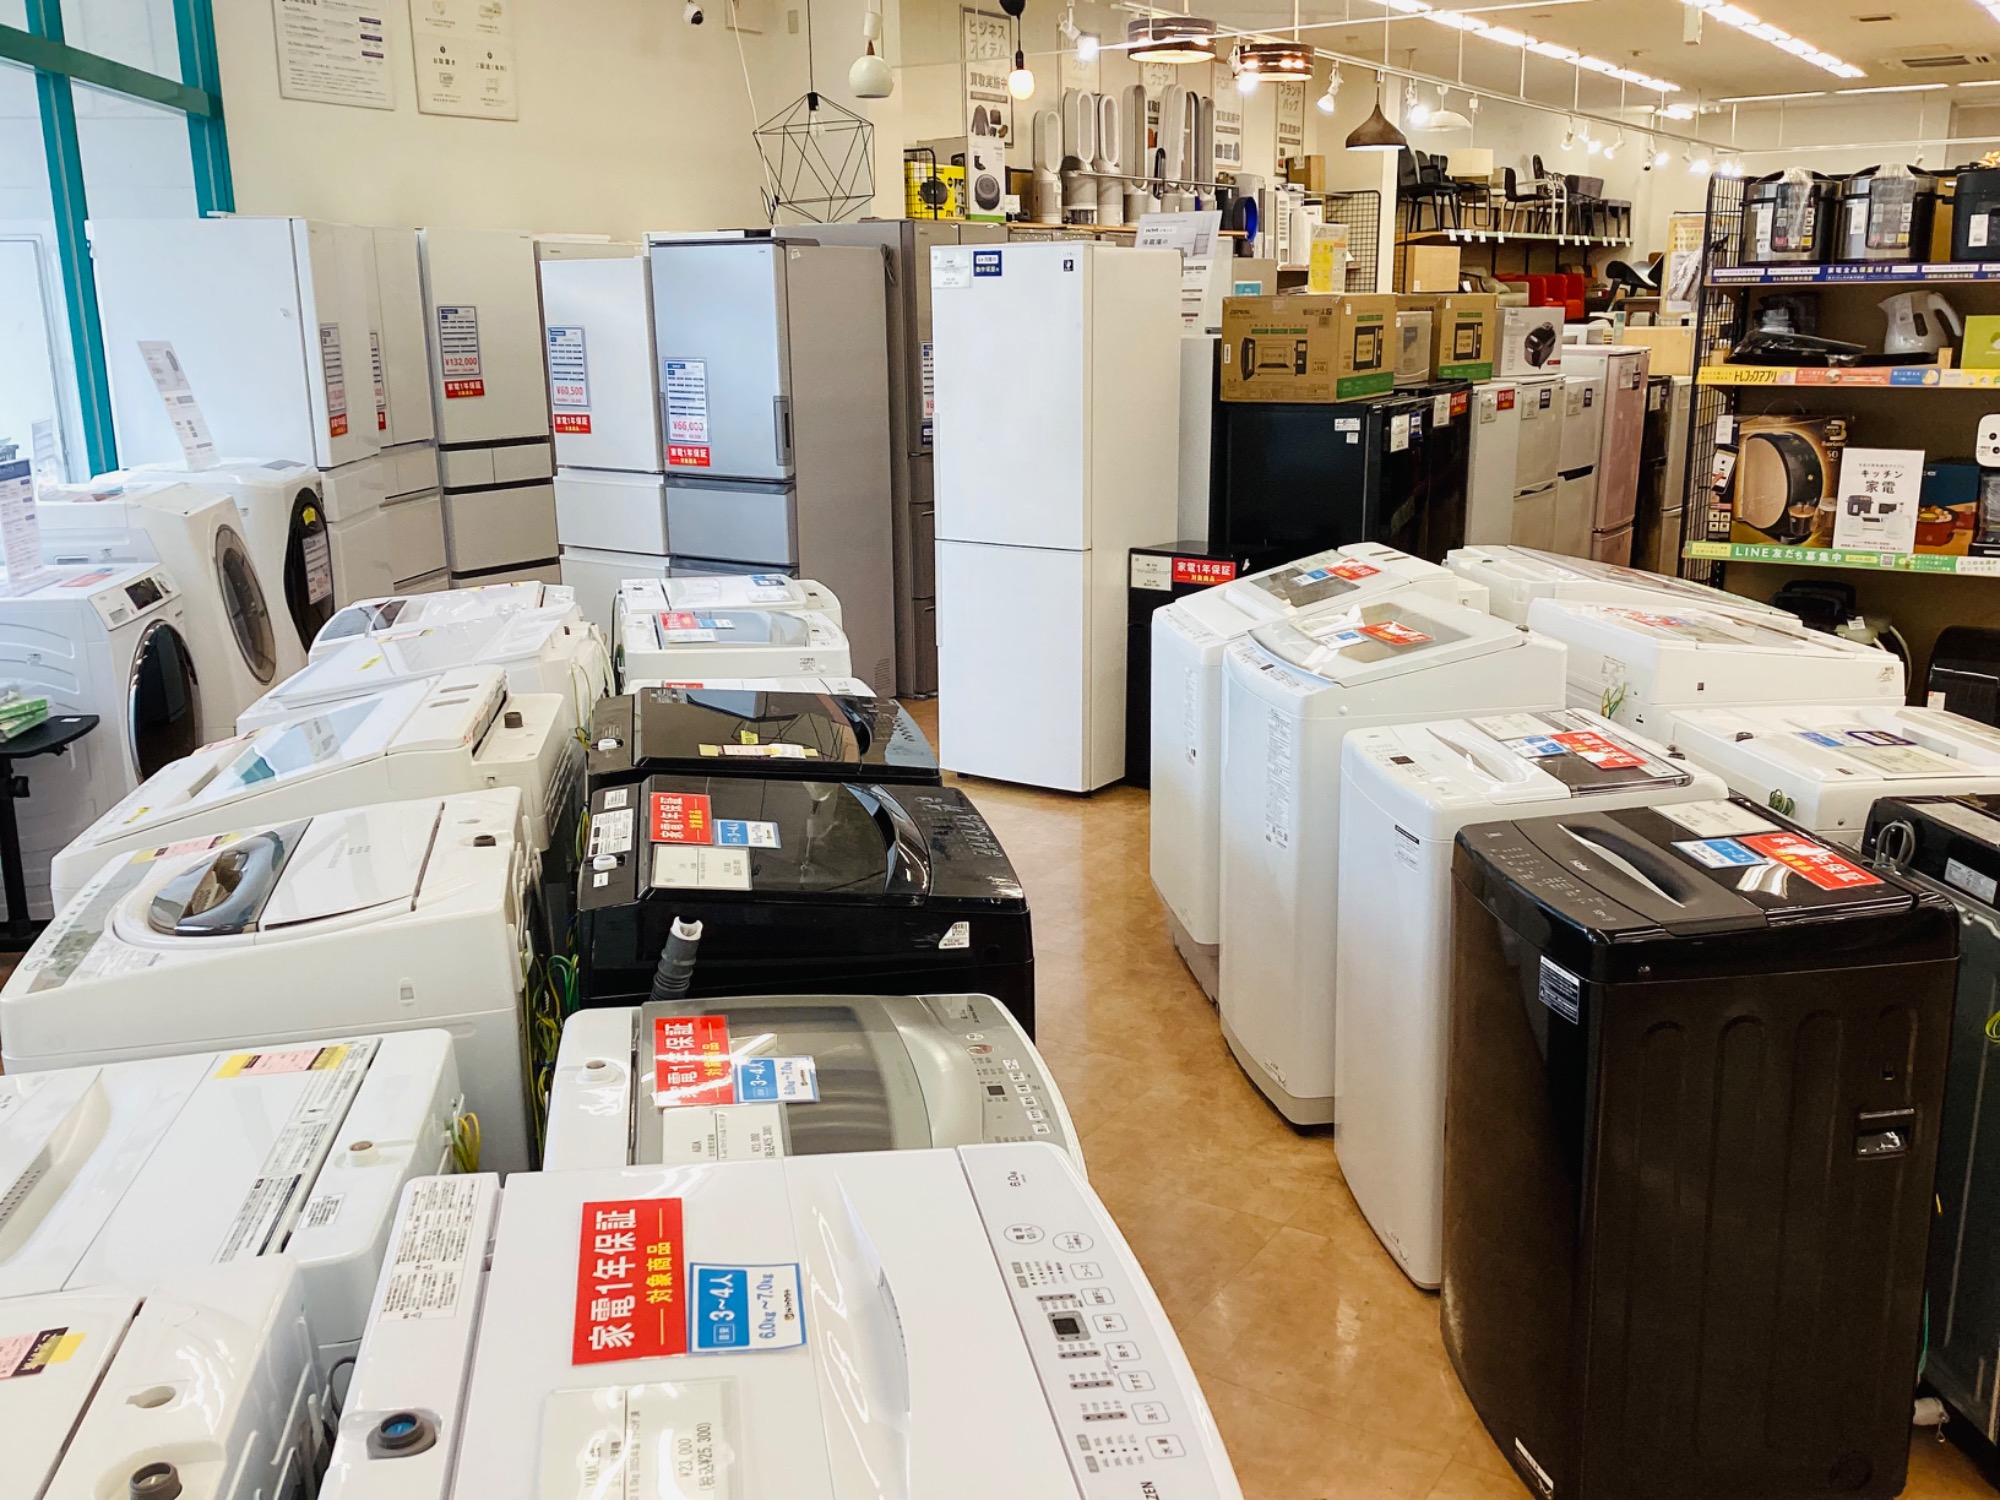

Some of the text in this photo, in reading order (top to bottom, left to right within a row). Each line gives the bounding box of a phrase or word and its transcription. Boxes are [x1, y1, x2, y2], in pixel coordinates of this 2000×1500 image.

[968, 20, 1006, 39] ビジネス
[970, 72, 1008, 90] 買取実施中
[1860, 469, 1904, 479] キッチン
[1865, 480, 1896, 494] 家電
[1177, 561, 1231, 576] 家電1年保証
[660, 796, 684, 839] 家電1年保証
[1569, 858, 1591, 873] Haier
[587, 1208, 637, 1351] 家電1年保証
[646, 1241, 673, 1304] 対象商品
[678, 1438, 693, 1478] ¥23,000
[696, 1422, 715, 1491] (税込¥25,300)
